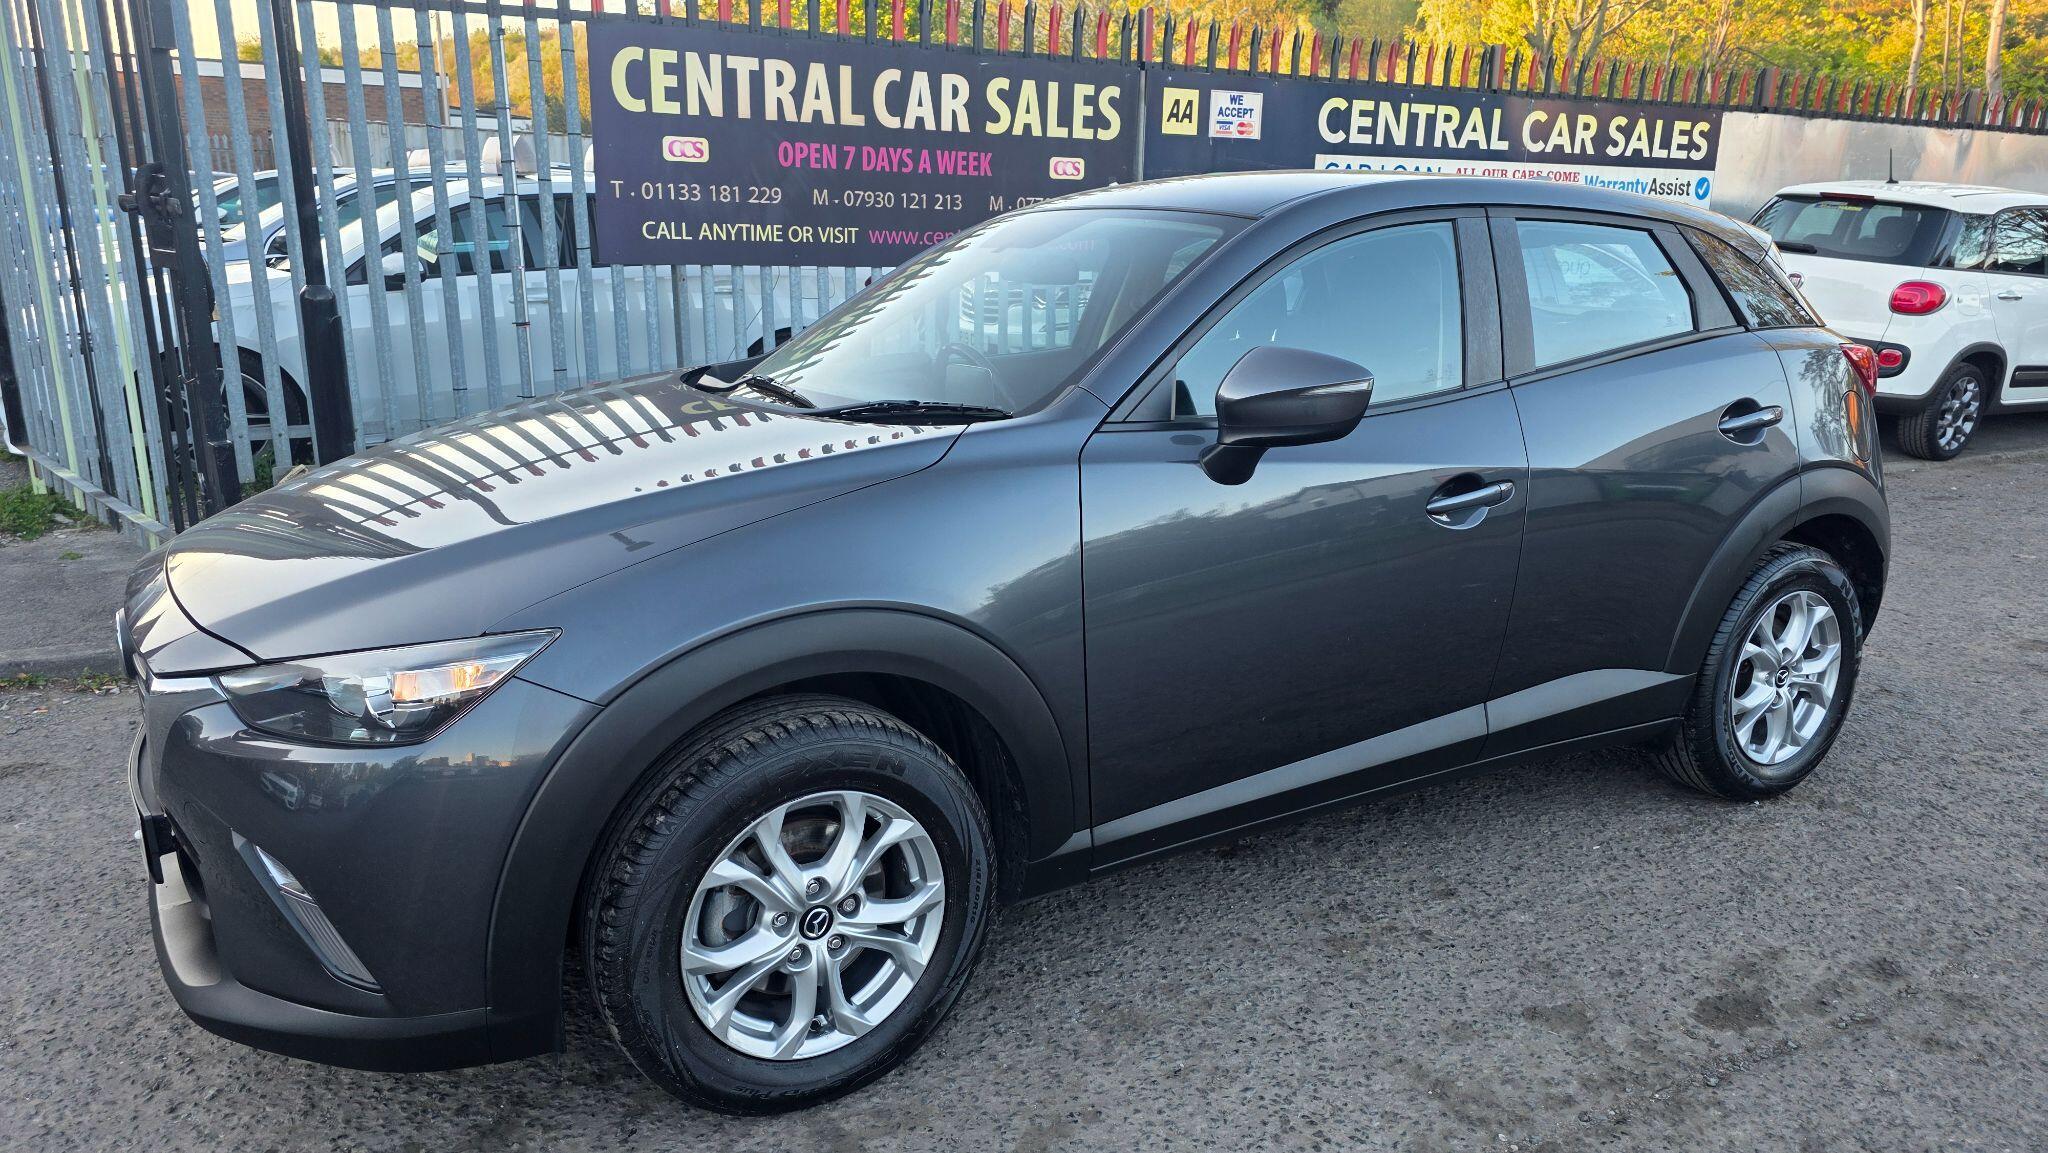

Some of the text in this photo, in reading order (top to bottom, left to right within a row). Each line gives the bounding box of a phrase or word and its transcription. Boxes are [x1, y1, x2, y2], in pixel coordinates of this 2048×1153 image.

[611, 46, 1121, 141] CENTRAL CAR SALES
[1229, 94, 1244, 105] WE
[1167, 98, 1193, 123] AA
[1217, 106, 1254, 118] ACCEPT
[1317, 97, 1710, 161] CENTRAL CAR SALES
[778, 141, 993, 177] OPEN 7 DAYS A WEEK
[1455, 167, 1476, 176] ALL
[1482, 168, 1508, 178] OUR
[1546, 171, 1581, 183] COME
[641, 181, 701, 201] 01133
[709, 184, 740, 203] 181
[748, 186, 782, 204] 229
[843, 190, 895, 208] 07930
[901, 192, 927, 209] 121
[934, 194, 963, 211] 213
[642, 221, 693, 240] CALL
[699, 223, 783, 242] ANYTIME
[788, 225, 813, 243] OR
[818, 226, 859, 245] VISIT
